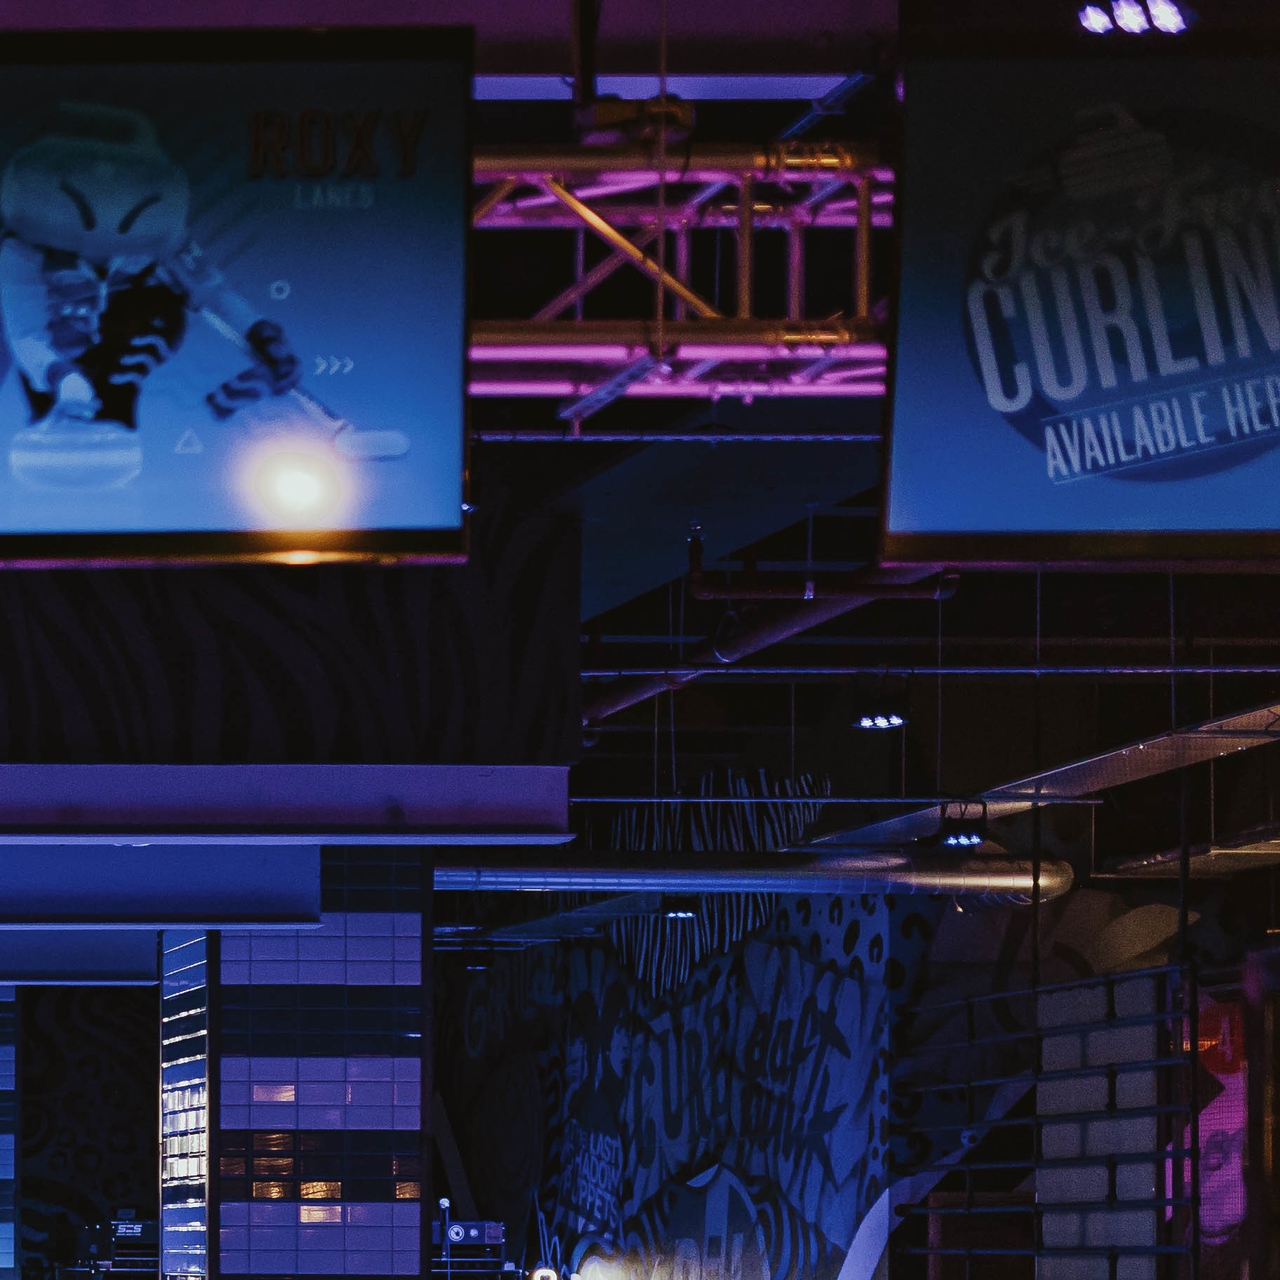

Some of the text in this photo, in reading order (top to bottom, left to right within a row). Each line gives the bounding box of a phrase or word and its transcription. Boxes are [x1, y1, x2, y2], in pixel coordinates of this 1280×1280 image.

[249, 107, 428, 179] ROXY
[966, 217, 1280, 414] CURLIN
[1044, 390, 1216, 480] AVAILABLE
